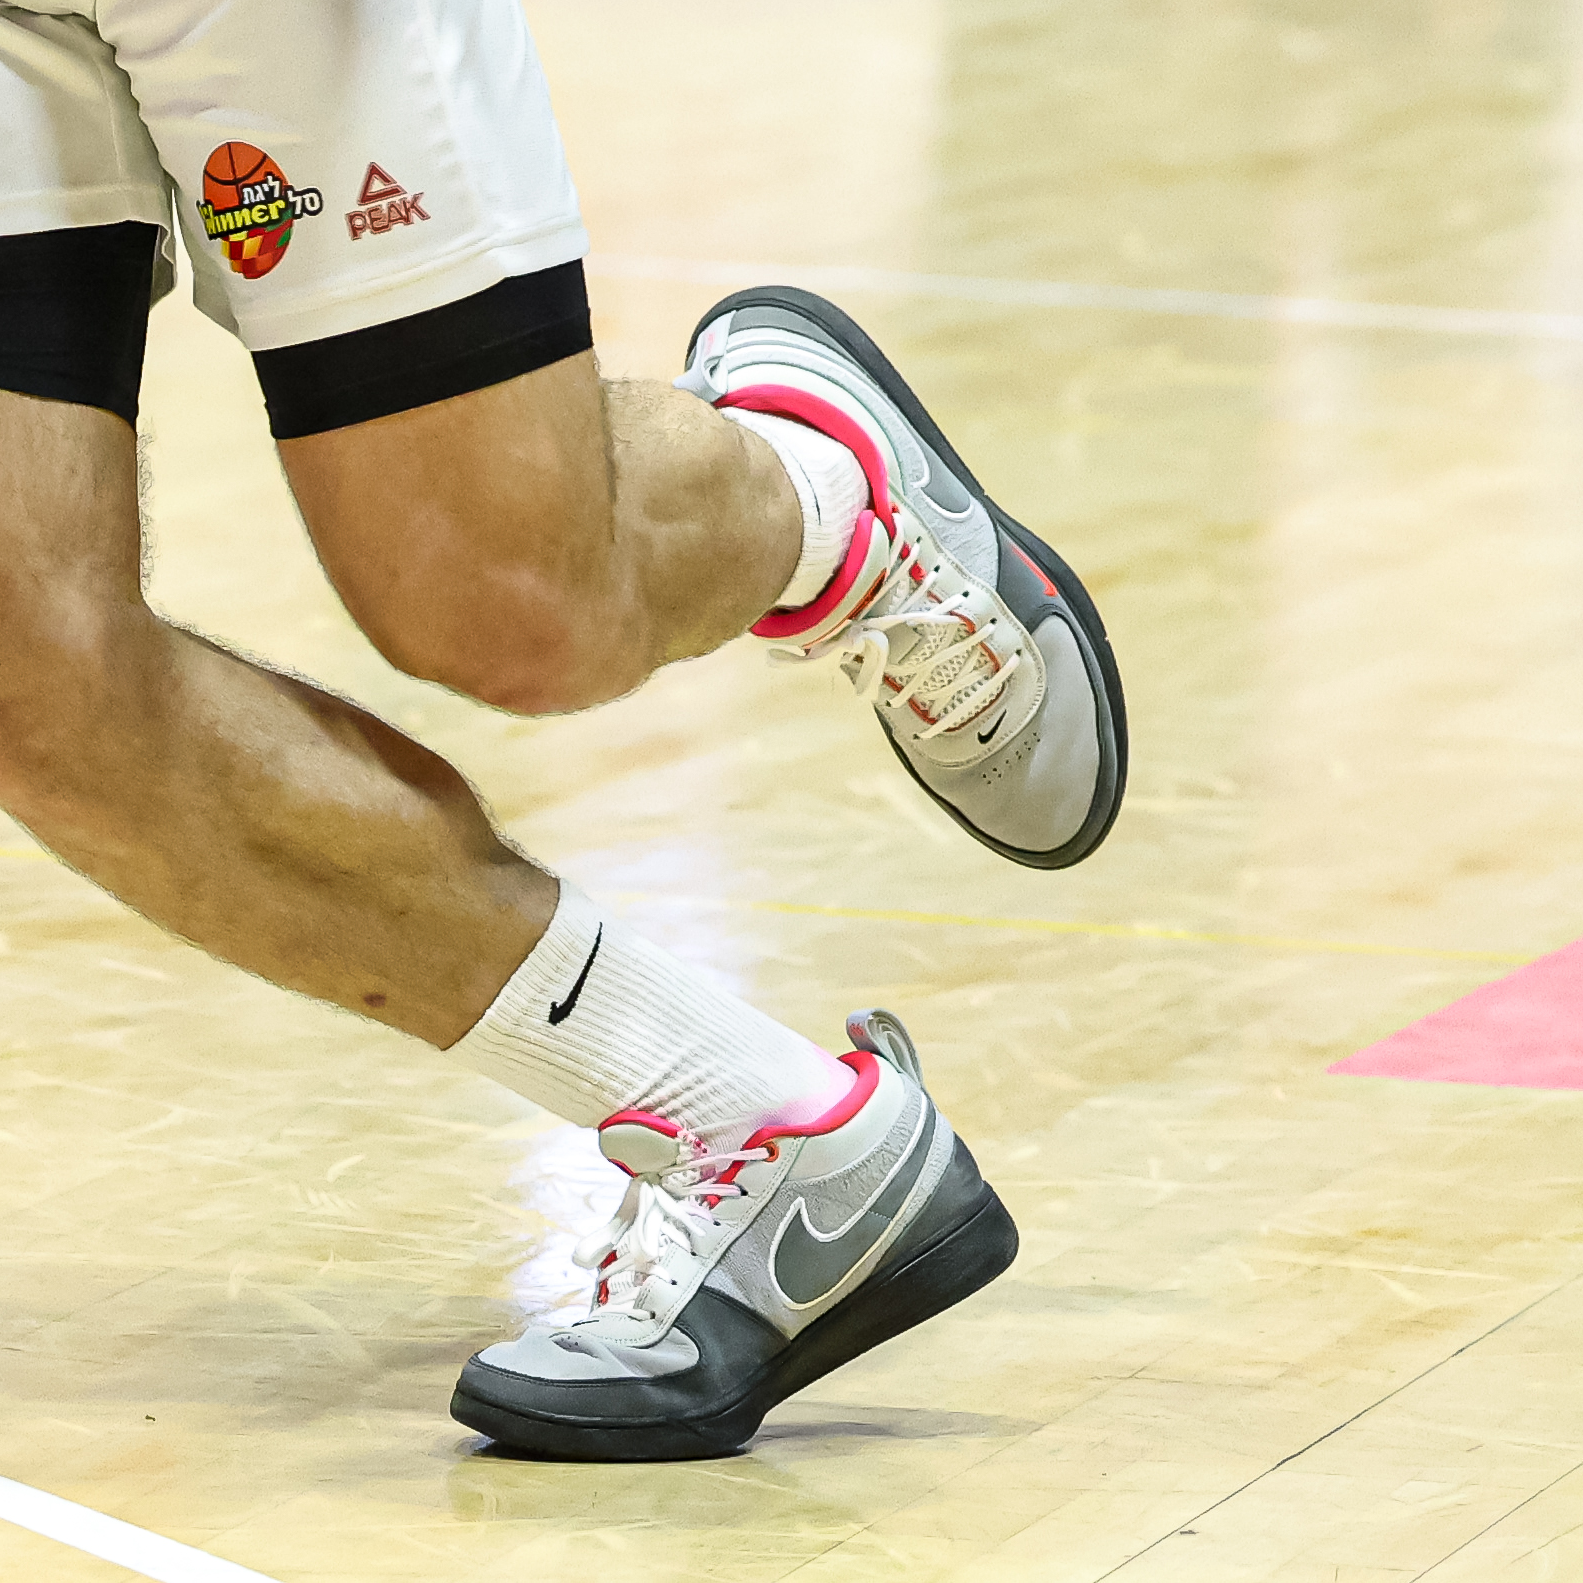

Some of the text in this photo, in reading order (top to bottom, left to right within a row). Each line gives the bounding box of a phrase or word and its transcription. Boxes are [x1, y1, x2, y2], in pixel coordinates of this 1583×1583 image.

[242, 176, 281, 205] ליגת
[287, 190, 320, 216] סל
[346, 191, 431, 241] PEAK
